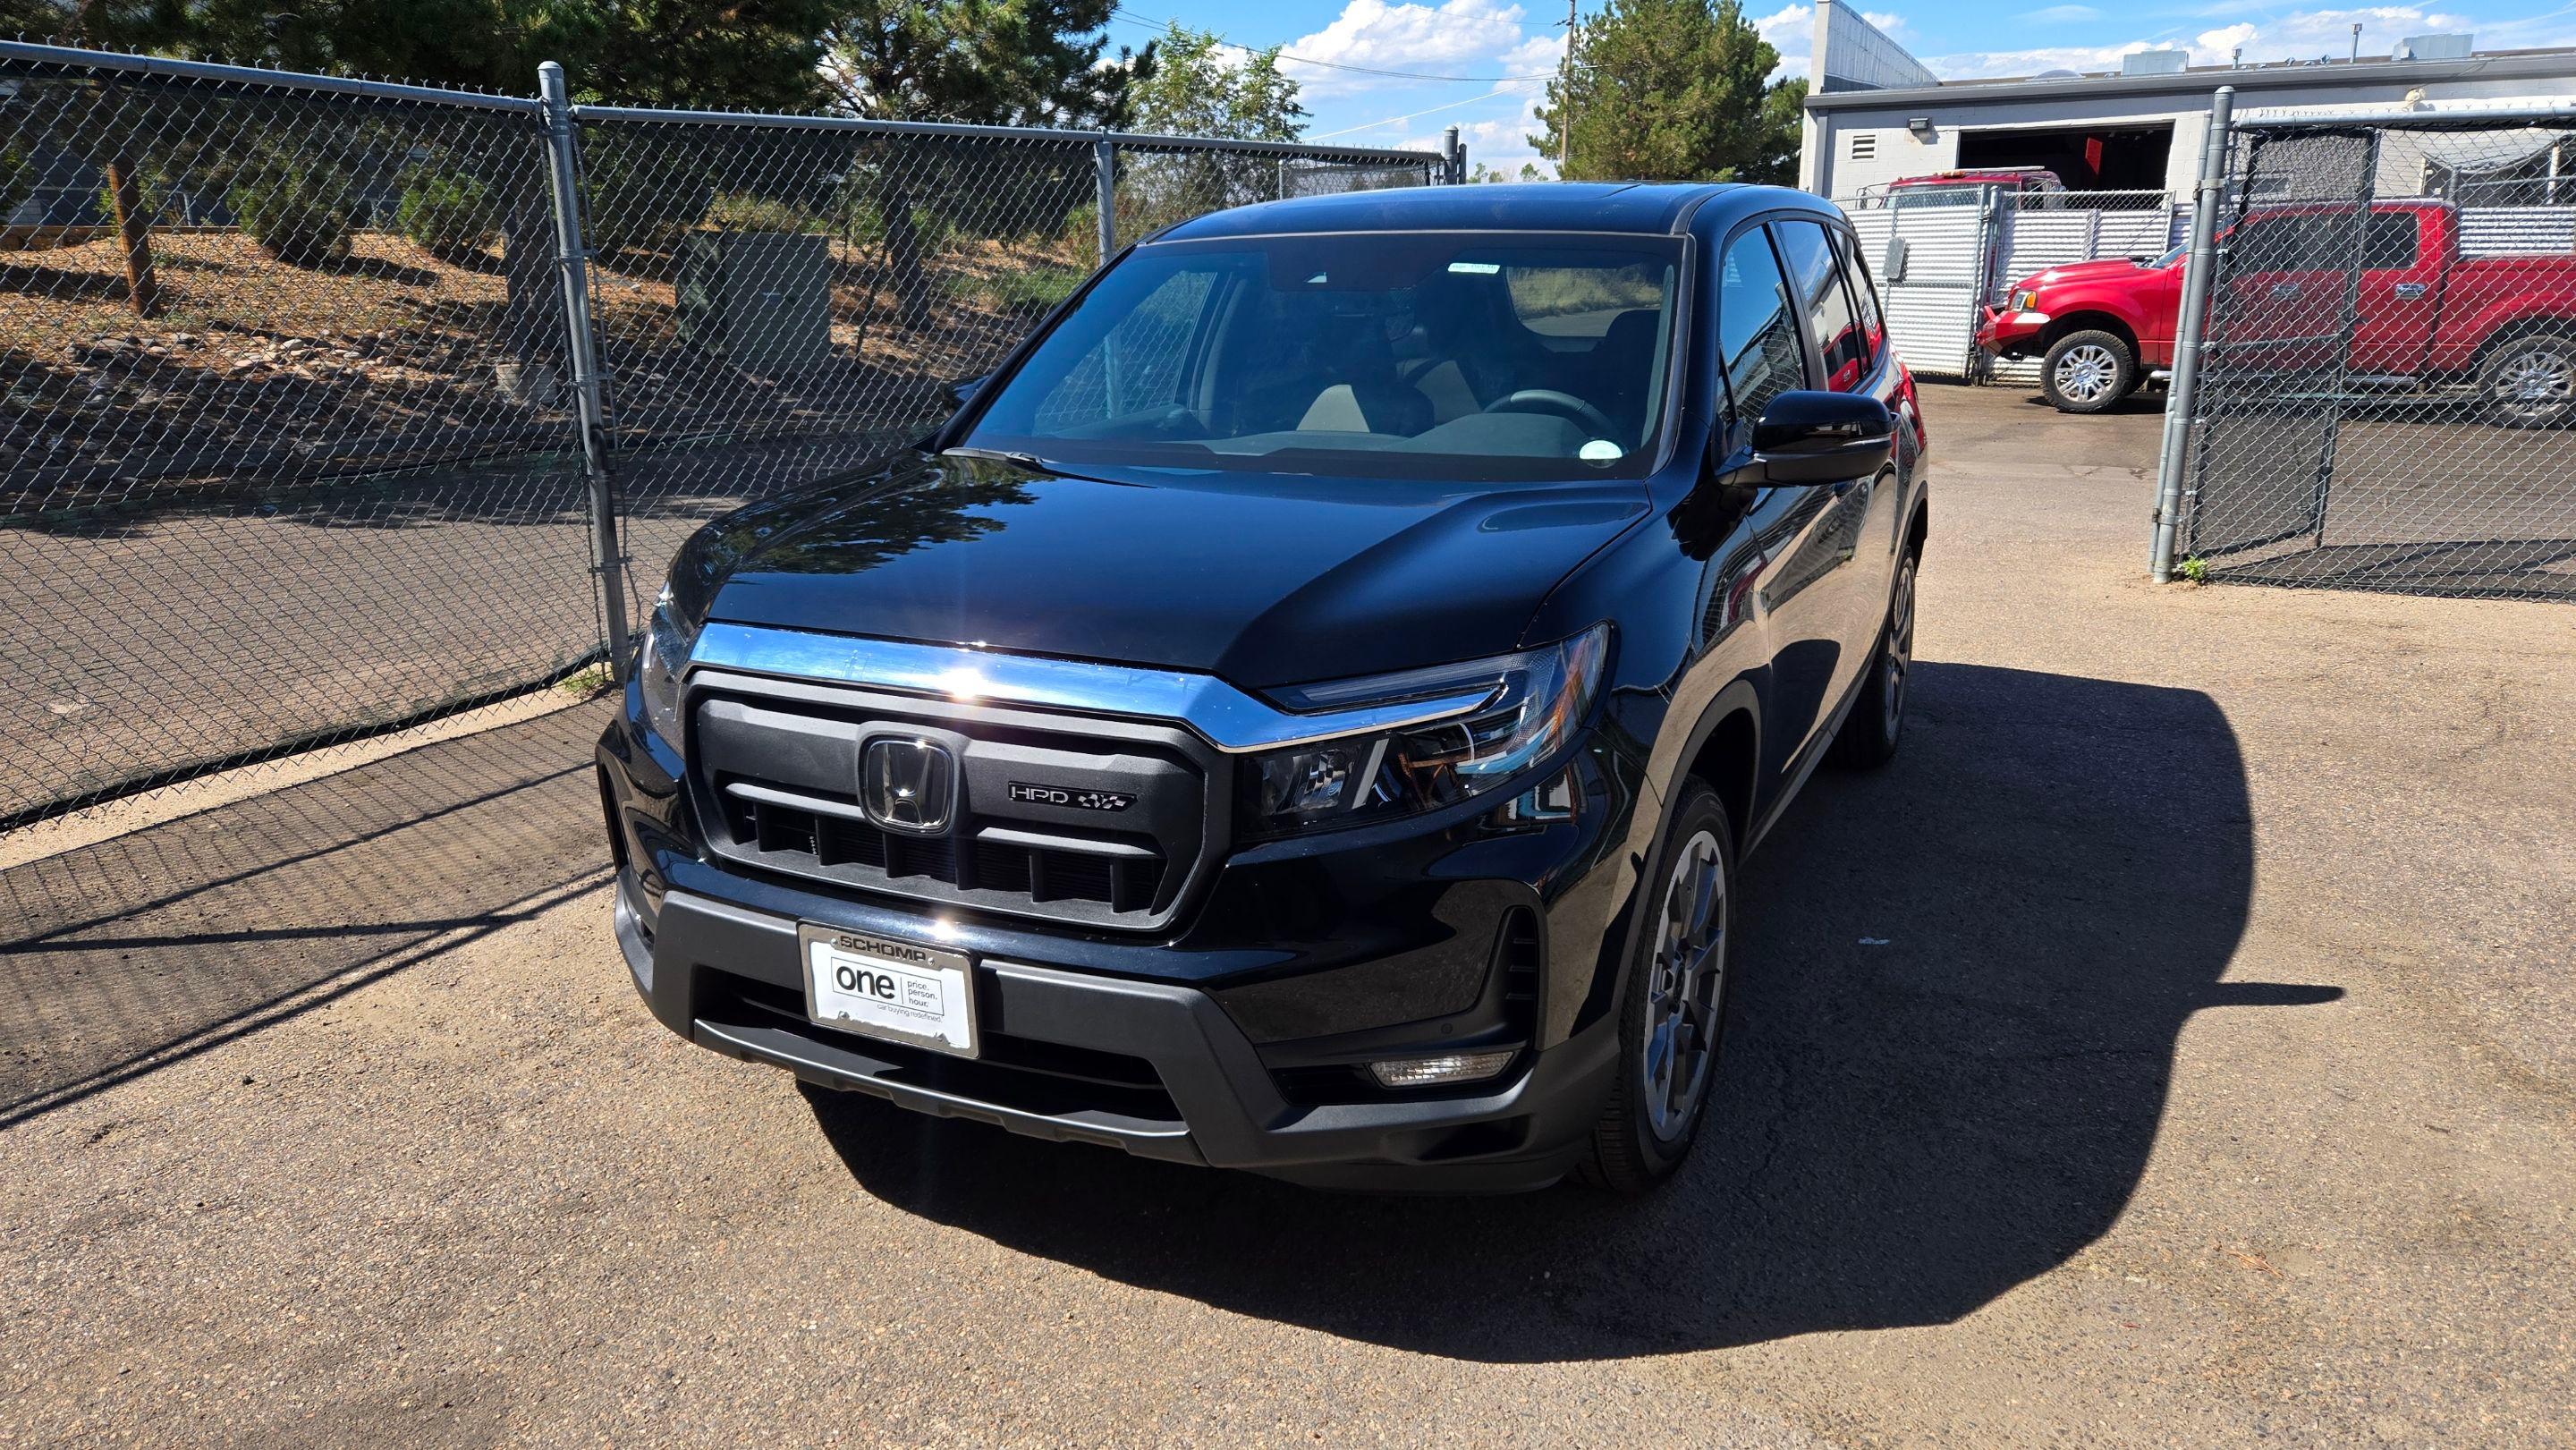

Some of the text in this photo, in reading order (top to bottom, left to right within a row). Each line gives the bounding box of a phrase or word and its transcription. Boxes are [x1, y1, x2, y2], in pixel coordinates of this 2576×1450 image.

[1012, 786, 1069, 803] HPD
[840, 936, 927, 961] SCHOMP
[836, 965, 895, 999] one
[907, 979, 929, 991] price.
[888, 1005, 911, 1017] buying
